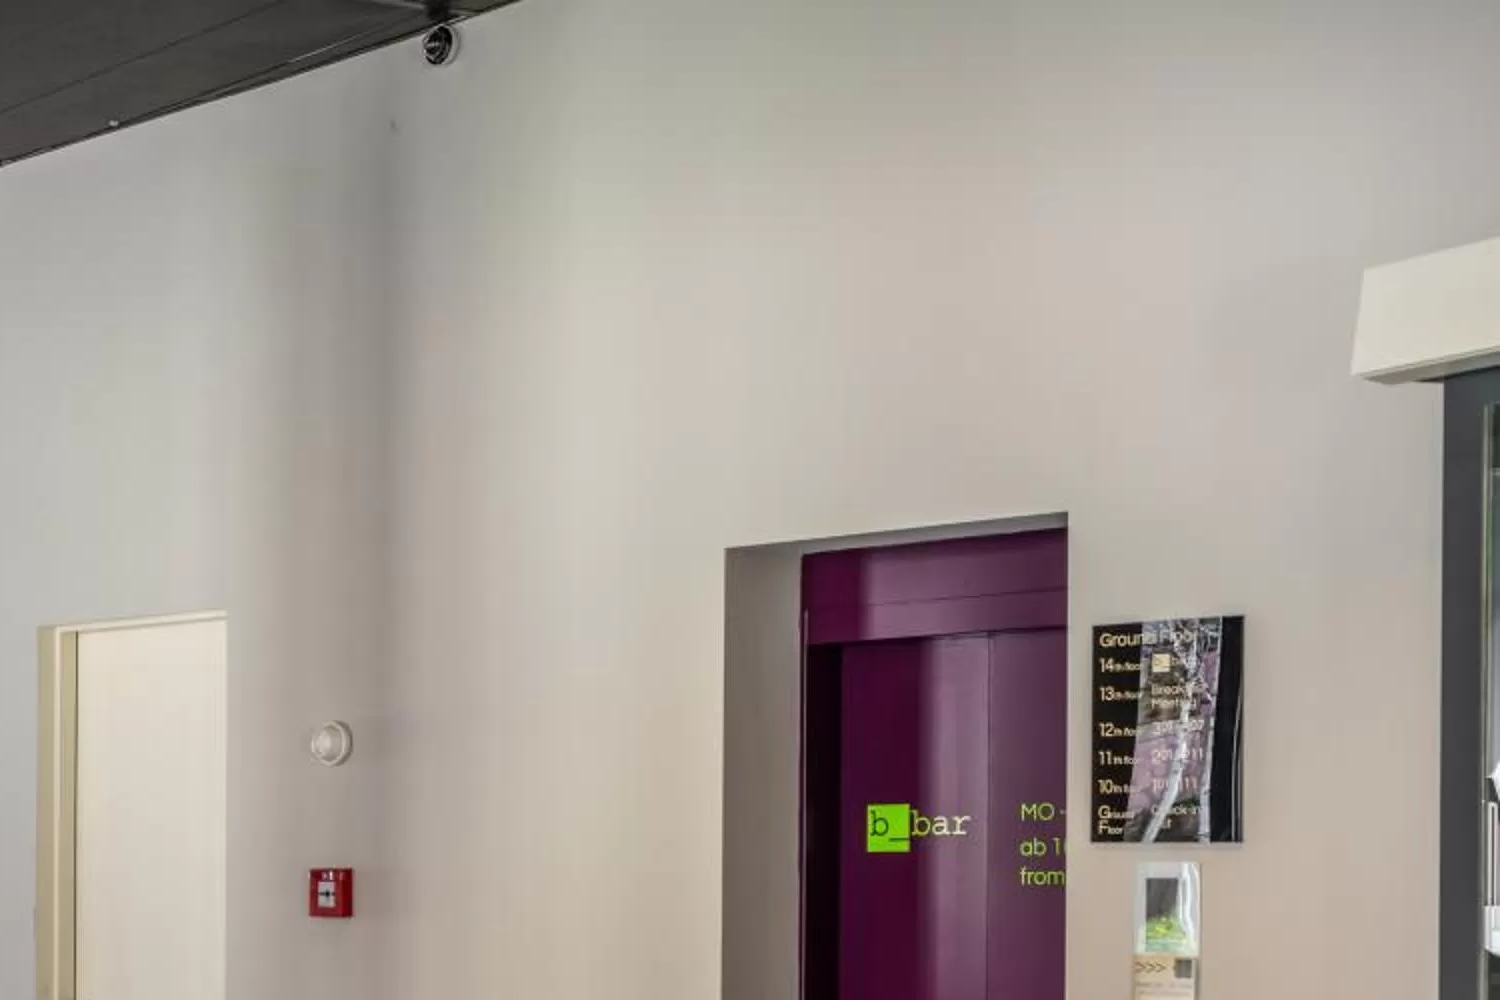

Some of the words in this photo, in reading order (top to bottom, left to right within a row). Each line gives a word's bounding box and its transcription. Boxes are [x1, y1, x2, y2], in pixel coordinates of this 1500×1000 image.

[1021, 803, 1055, 821] MO
[1020, 838, 1047, 856] ab
[1053, 838, 1067, 856] 1
[1020, 867, 1066, 886] from
